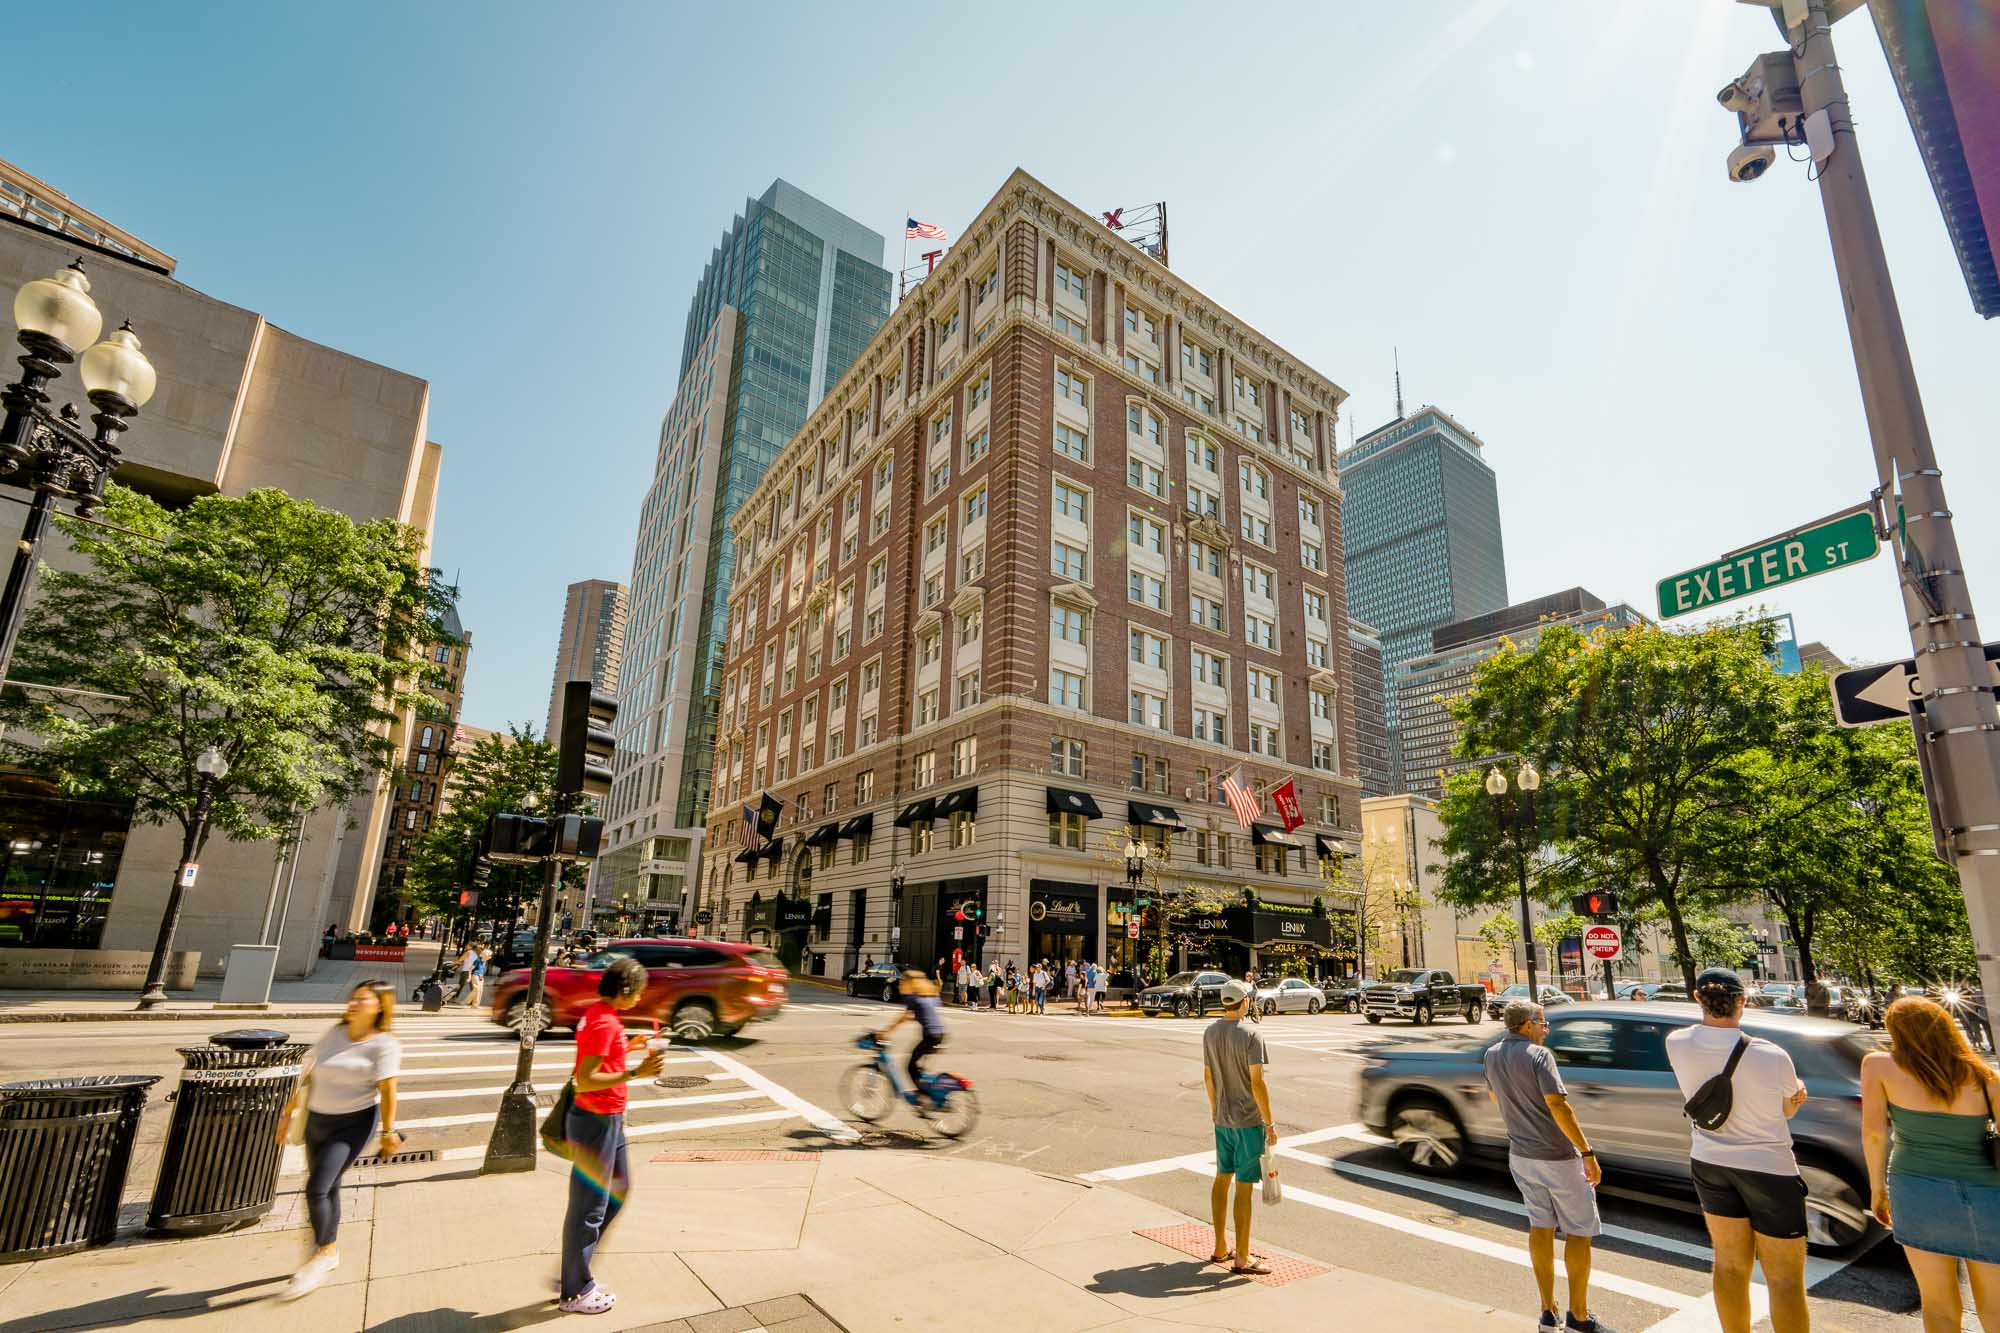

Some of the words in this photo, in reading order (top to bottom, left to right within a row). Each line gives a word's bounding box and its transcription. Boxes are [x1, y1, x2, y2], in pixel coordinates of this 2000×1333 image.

[1675, 541, 1809, 611] EXETER
[1825, 541, 1849, 565] ST
[1050, 900, 1074, 913] Lindt
[1198, 919, 1228, 929] LENOX
[1281, 921, 1306, 934] LENOX
[204, 1070, 244, 1080] Recycle
